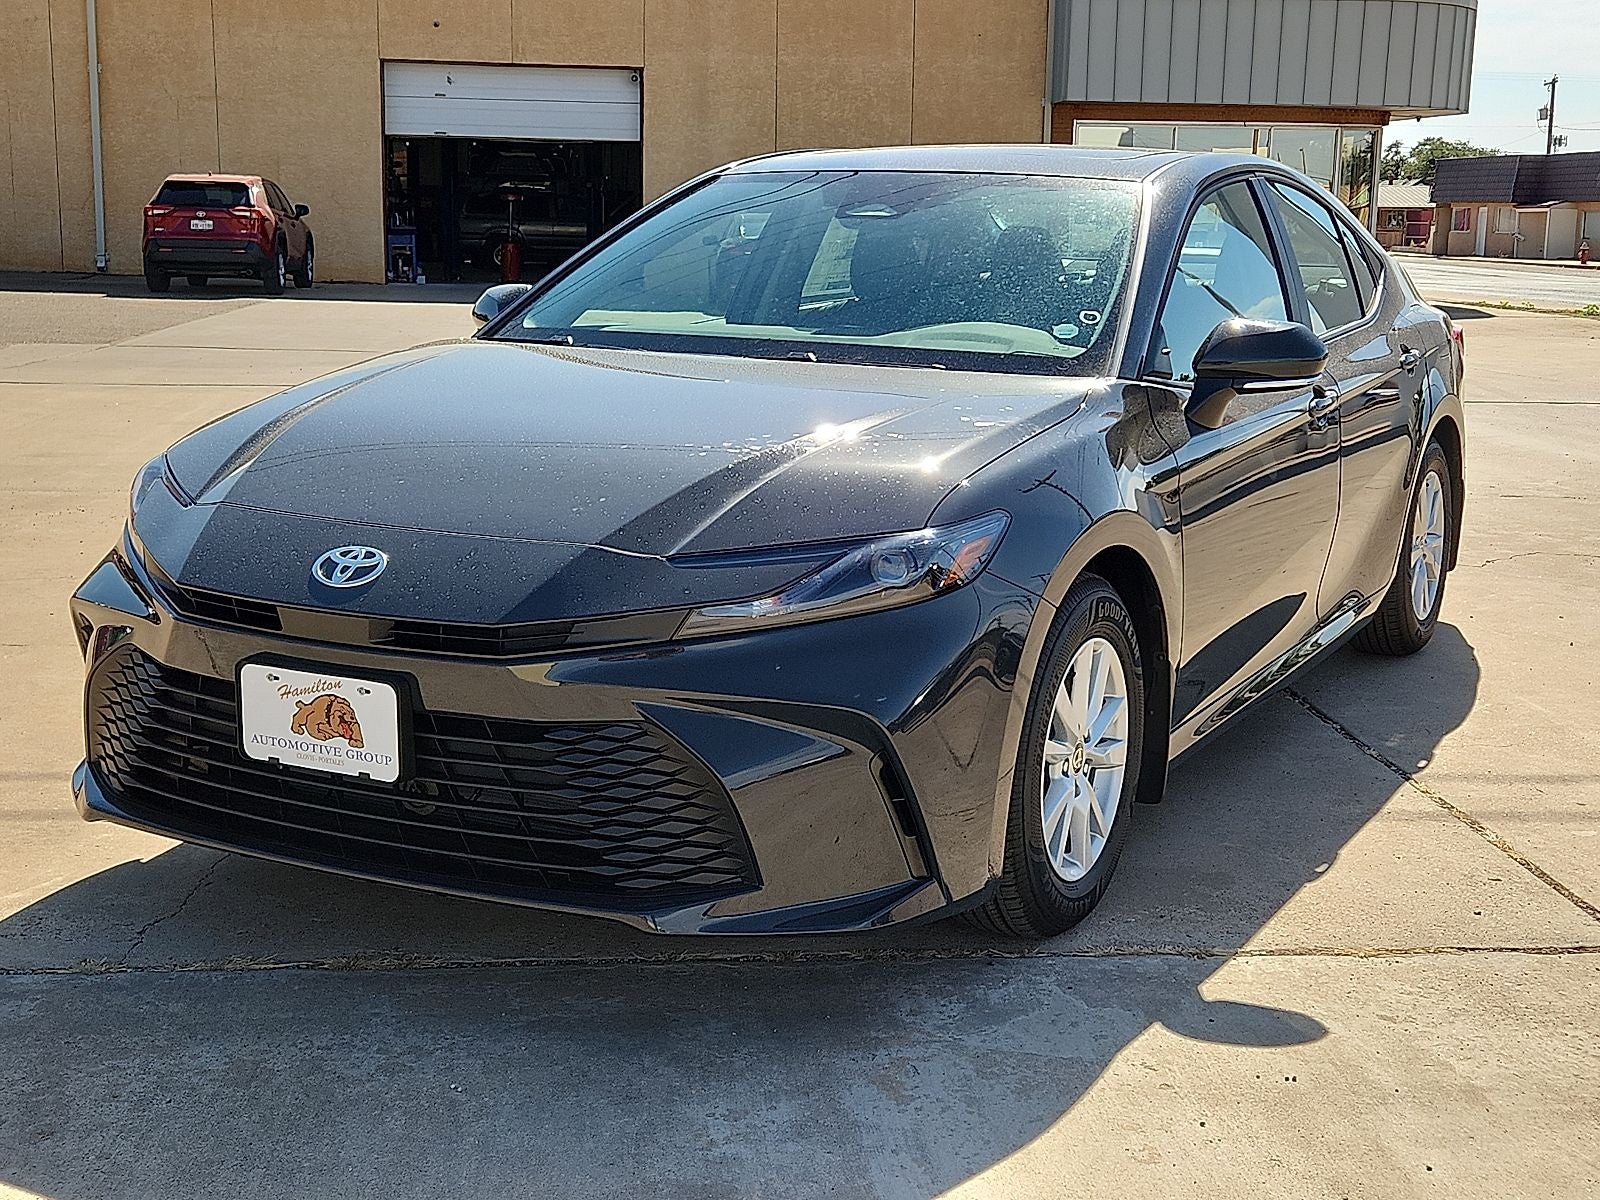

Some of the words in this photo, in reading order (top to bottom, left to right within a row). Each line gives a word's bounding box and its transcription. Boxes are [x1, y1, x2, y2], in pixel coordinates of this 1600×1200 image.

[277, 679, 343, 699] Hamilton
[250, 734, 342, 757] AUTOMOTIVE
[345, 749, 392, 765] GROUP
